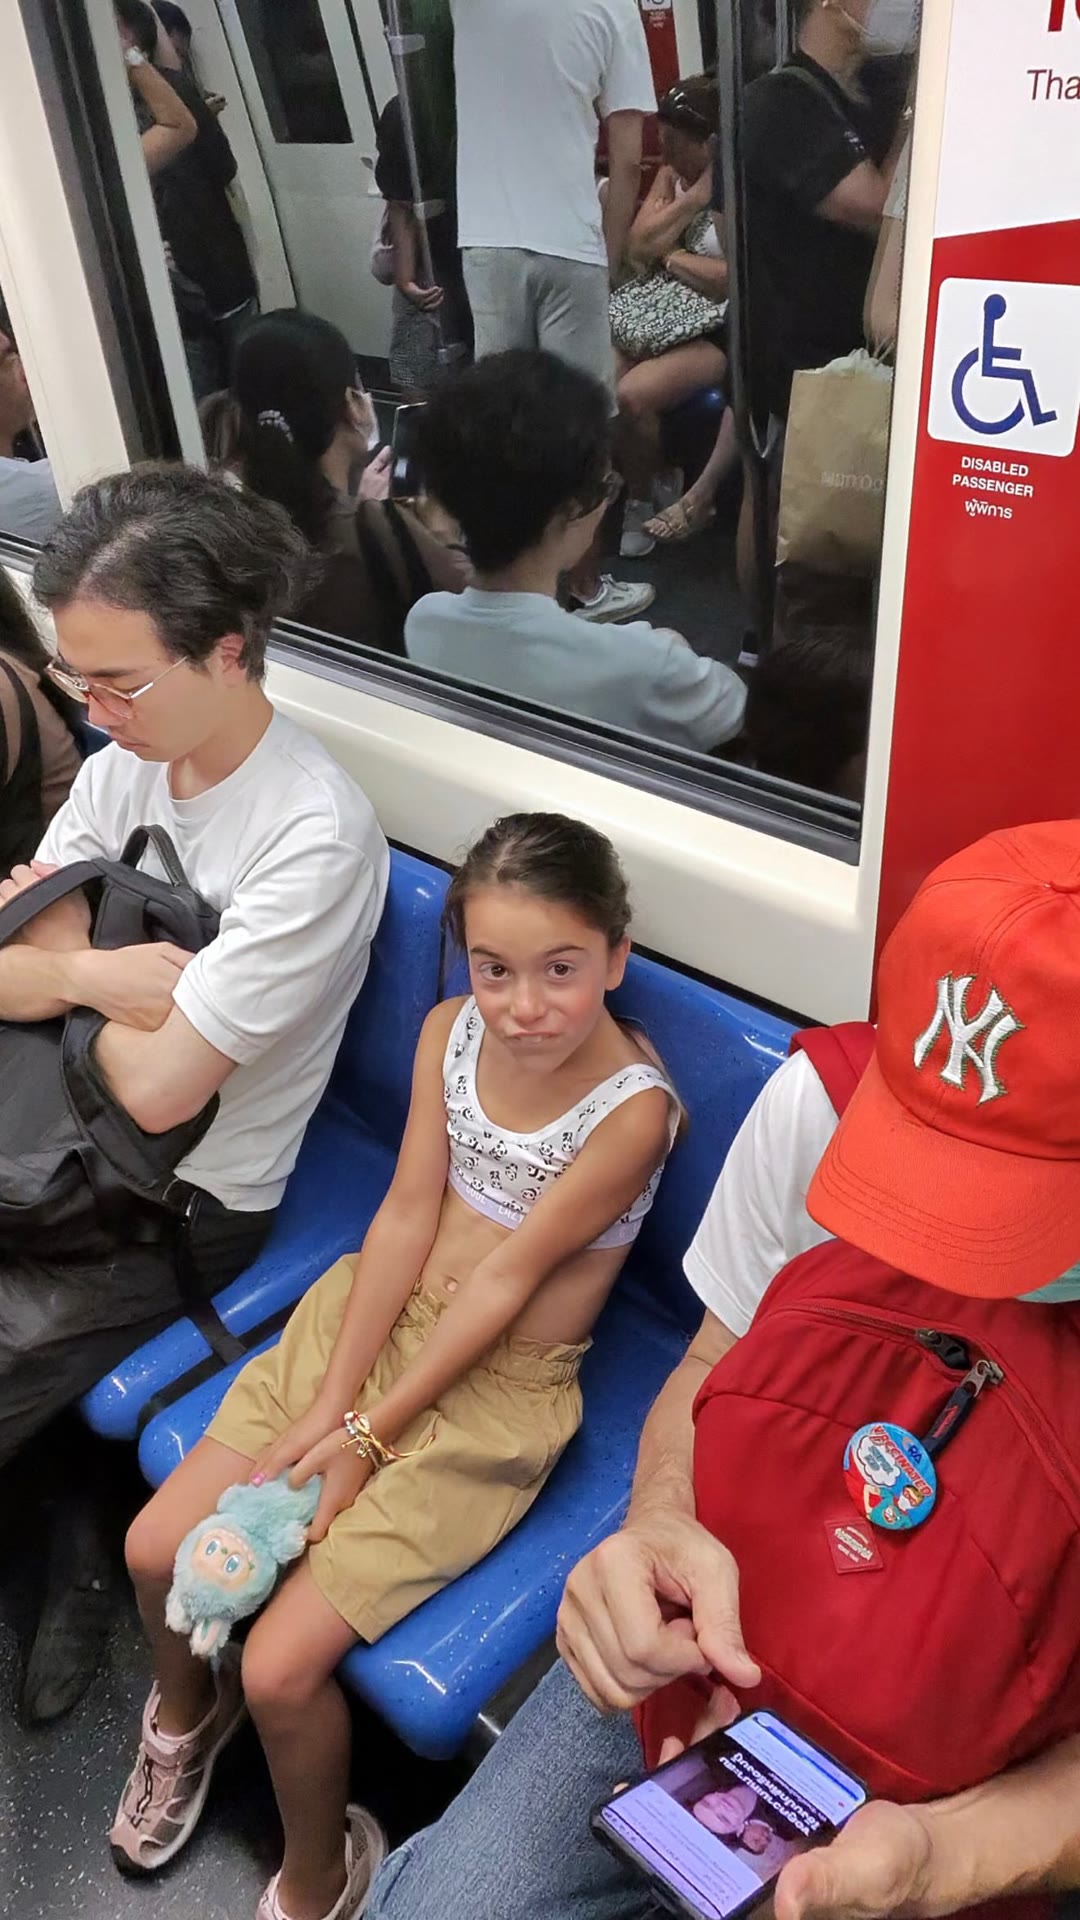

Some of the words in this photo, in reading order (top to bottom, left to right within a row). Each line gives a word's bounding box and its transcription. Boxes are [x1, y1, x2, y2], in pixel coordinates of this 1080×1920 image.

[961, 456, 1029, 477] DISABLED
[952, 474, 1034, 498] PASSENGER
[965, 498, 1013, 519] ผู้พิการ
[912, 972, 1026, 1107] NY
[869, 1424, 933, 1497] VACCINATED
